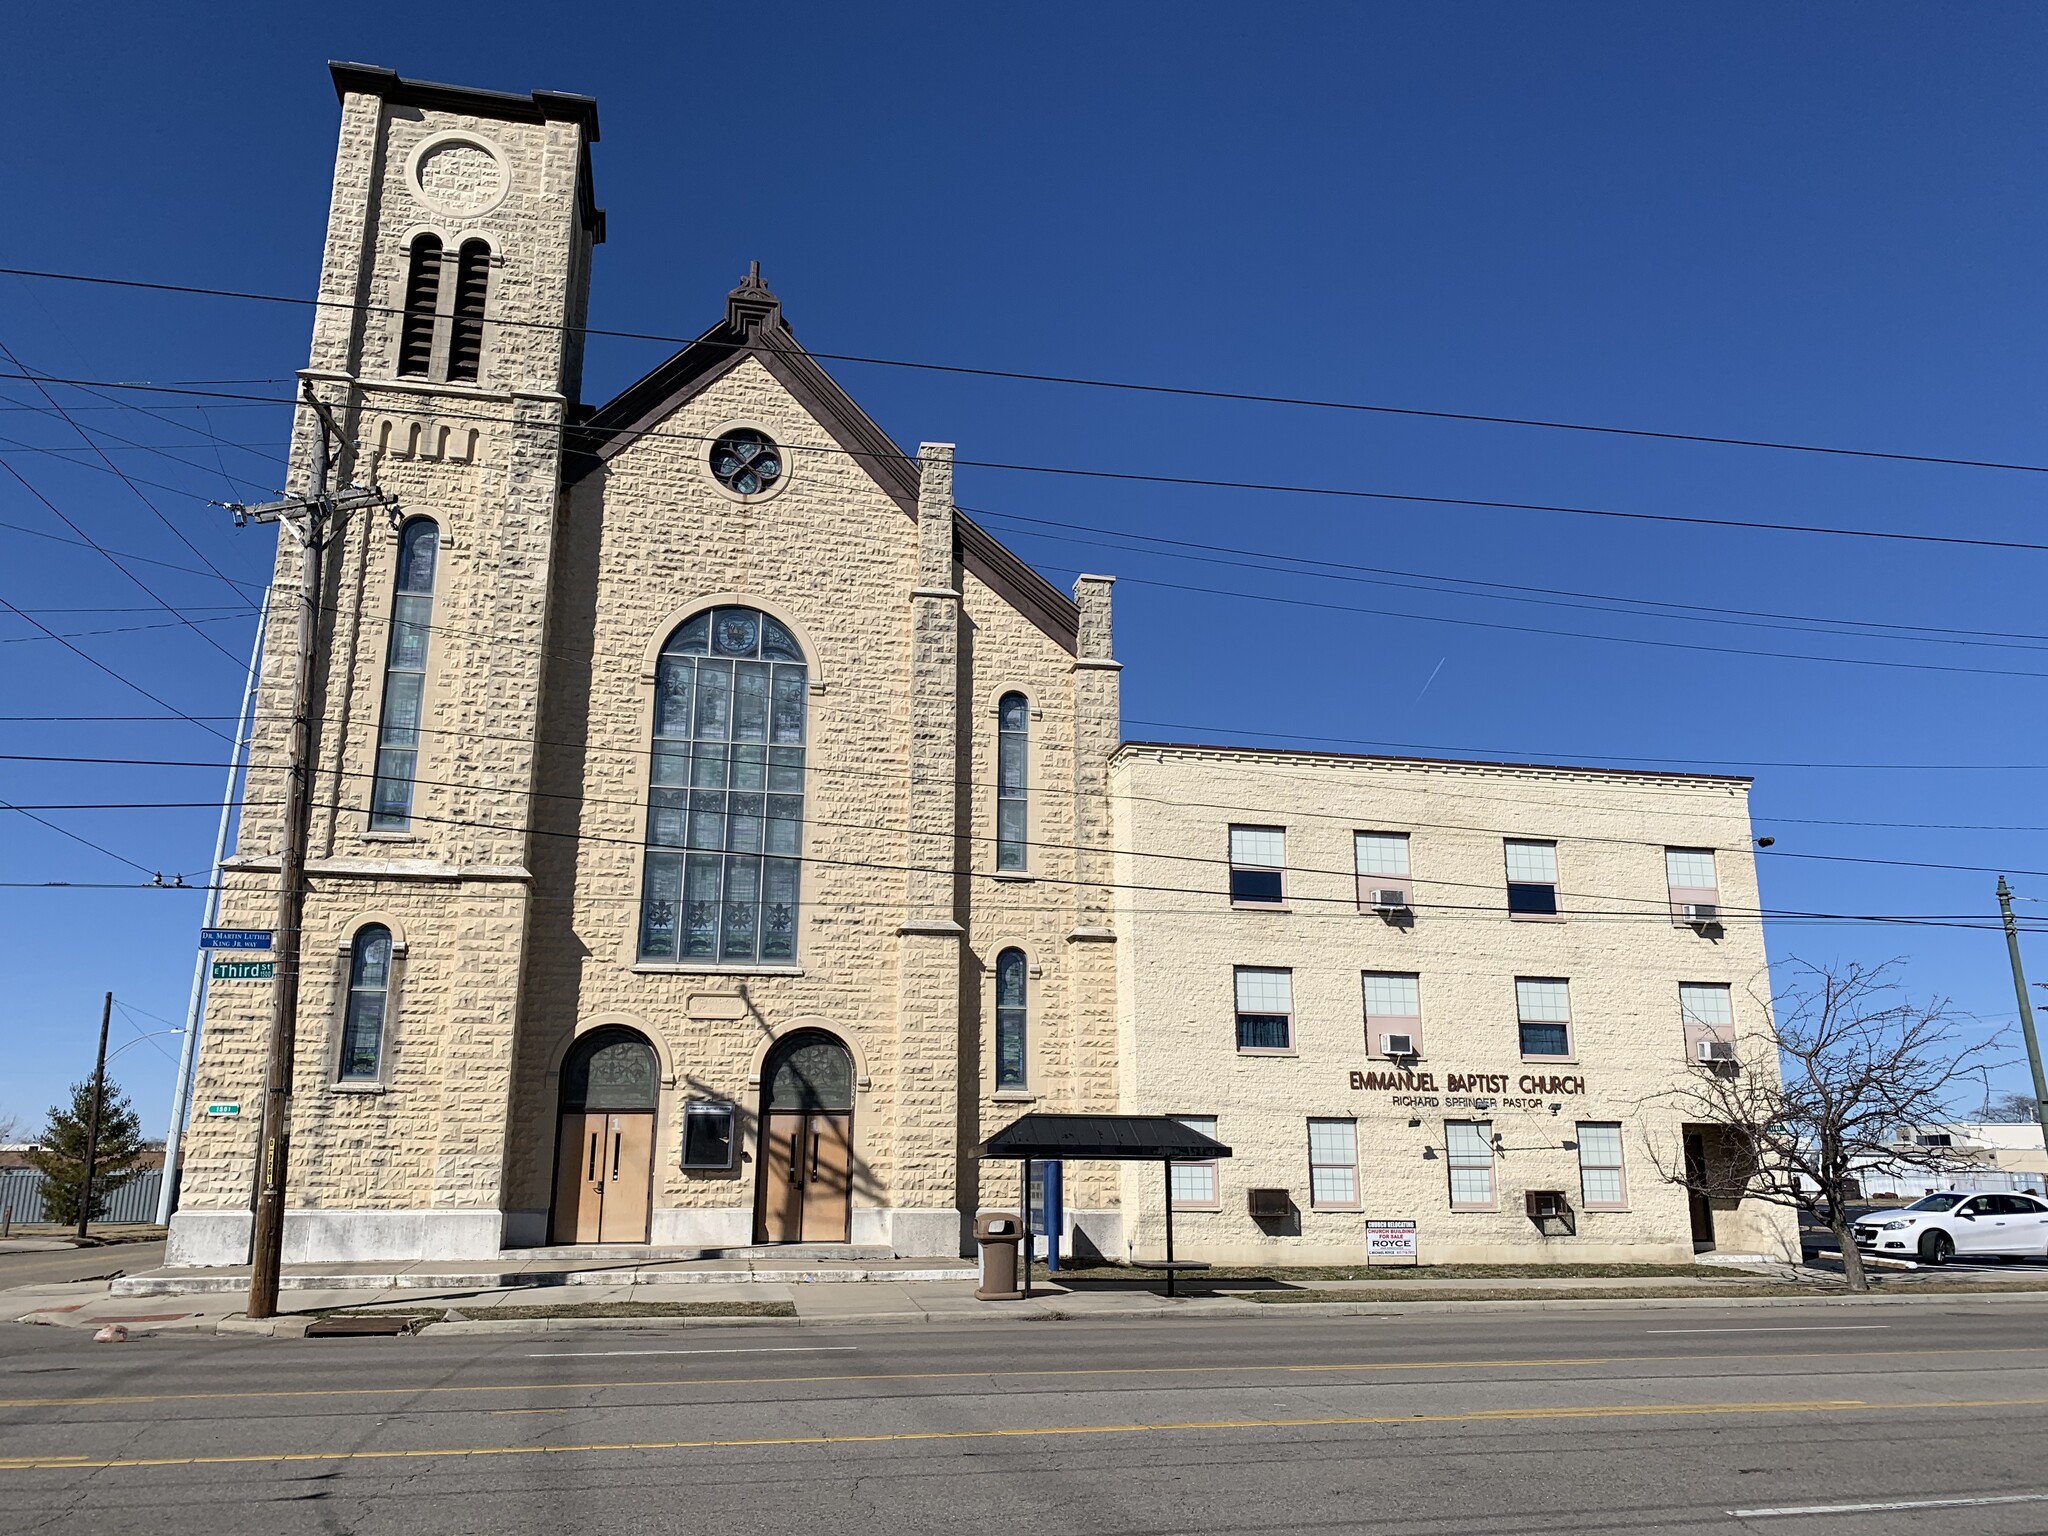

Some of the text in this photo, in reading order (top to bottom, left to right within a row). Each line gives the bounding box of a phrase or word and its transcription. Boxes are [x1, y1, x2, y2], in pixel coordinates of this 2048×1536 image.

[220, 964, 260, 977] Third
[1350, 1071, 1585, 1094] EMMANUEL BAPTIST CHURCH
[1392, 1096, 1439, 1107] RICHARD
[1503, 1098, 1542, 1108] PASTOR
[612, 1118, 620, 1130] 1
